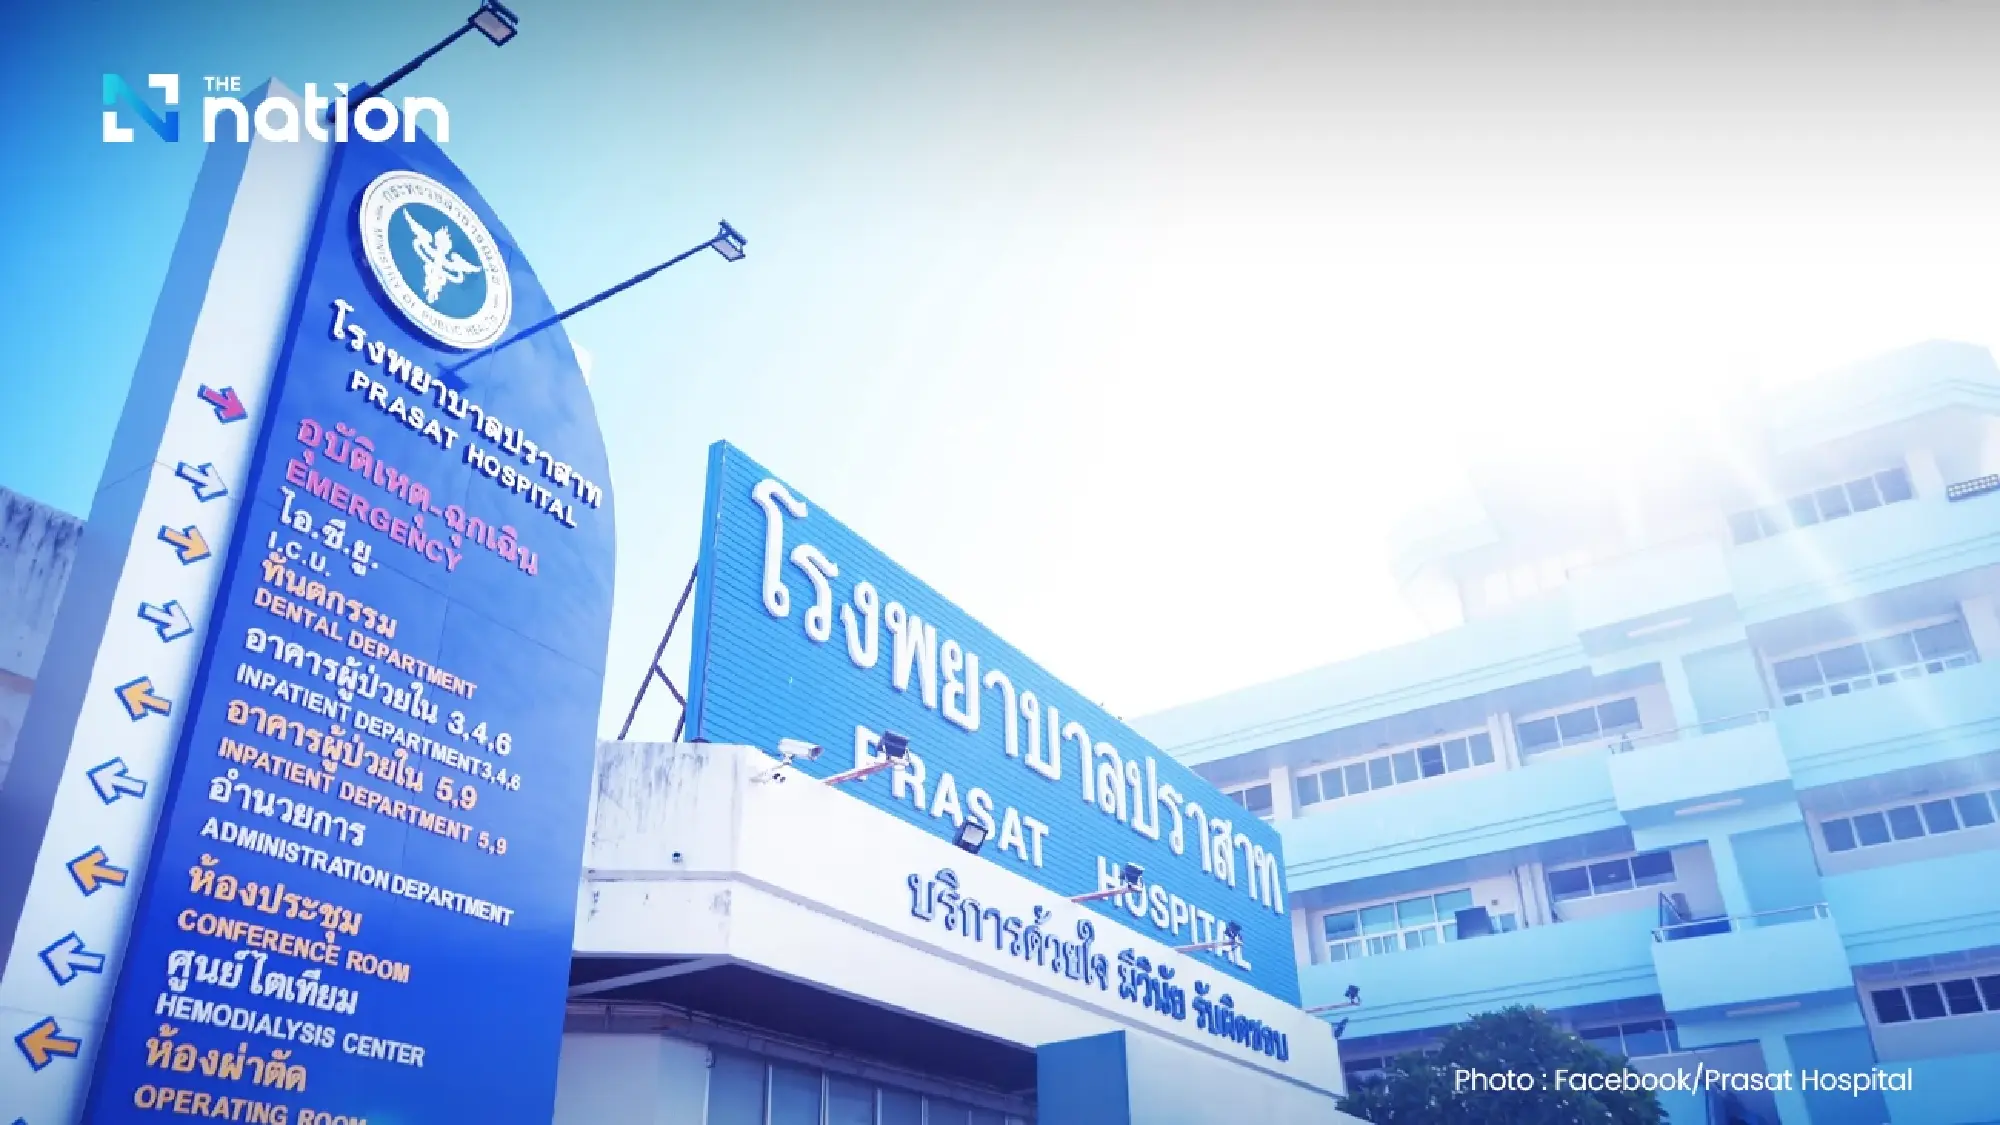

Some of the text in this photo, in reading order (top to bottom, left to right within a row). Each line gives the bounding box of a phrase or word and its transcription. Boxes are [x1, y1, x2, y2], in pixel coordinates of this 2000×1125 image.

[331, 298, 603, 509] โรงพยาบาลปราสาท
[351, 369, 578, 528] PRASAT HOSPITAL
[268, 531, 332, 577] I.C.U.
[286, 459, 463, 573] EMERGENCY
[254, 587, 478, 700] DENTAL DEPARTMENT
[261, 550, 398, 639] ทันตกรรม
[236, 663, 351, 723] INPATIENT
[246, 627, 513, 756] อาคารผู้ป่วยใน 3,4,6
[752, 478, 1285, 915] โรงพยาบาลปราสาท
[208, 768, 367, 849] อำนวยการ
[218, 737, 508, 855] INPATIENT DEPARTMENT 5,9
[227, 699, 478, 811] อาคารผู้ป่วยใน 5,9
[854, 725, 1049, 869] PRASAT
[188, 853, 363, 946] ห้องประชุม
[202, 817, 515, 927] ADMINISTRATION DEPARTMENT
[177, 909, 412, 984] CONFERENCE ROOM
[907, 868, 1109, 991] บริการด้วยใจ
[1117, 947, 1187, 1021] มีวินัย
[145, 1023, 308, 1093] ห้องผ่าตัด
[155, 992, 426, 1068] HEMODIALYSIS CENTER
[133, 1084, 368, 1125] OPERATING RO
